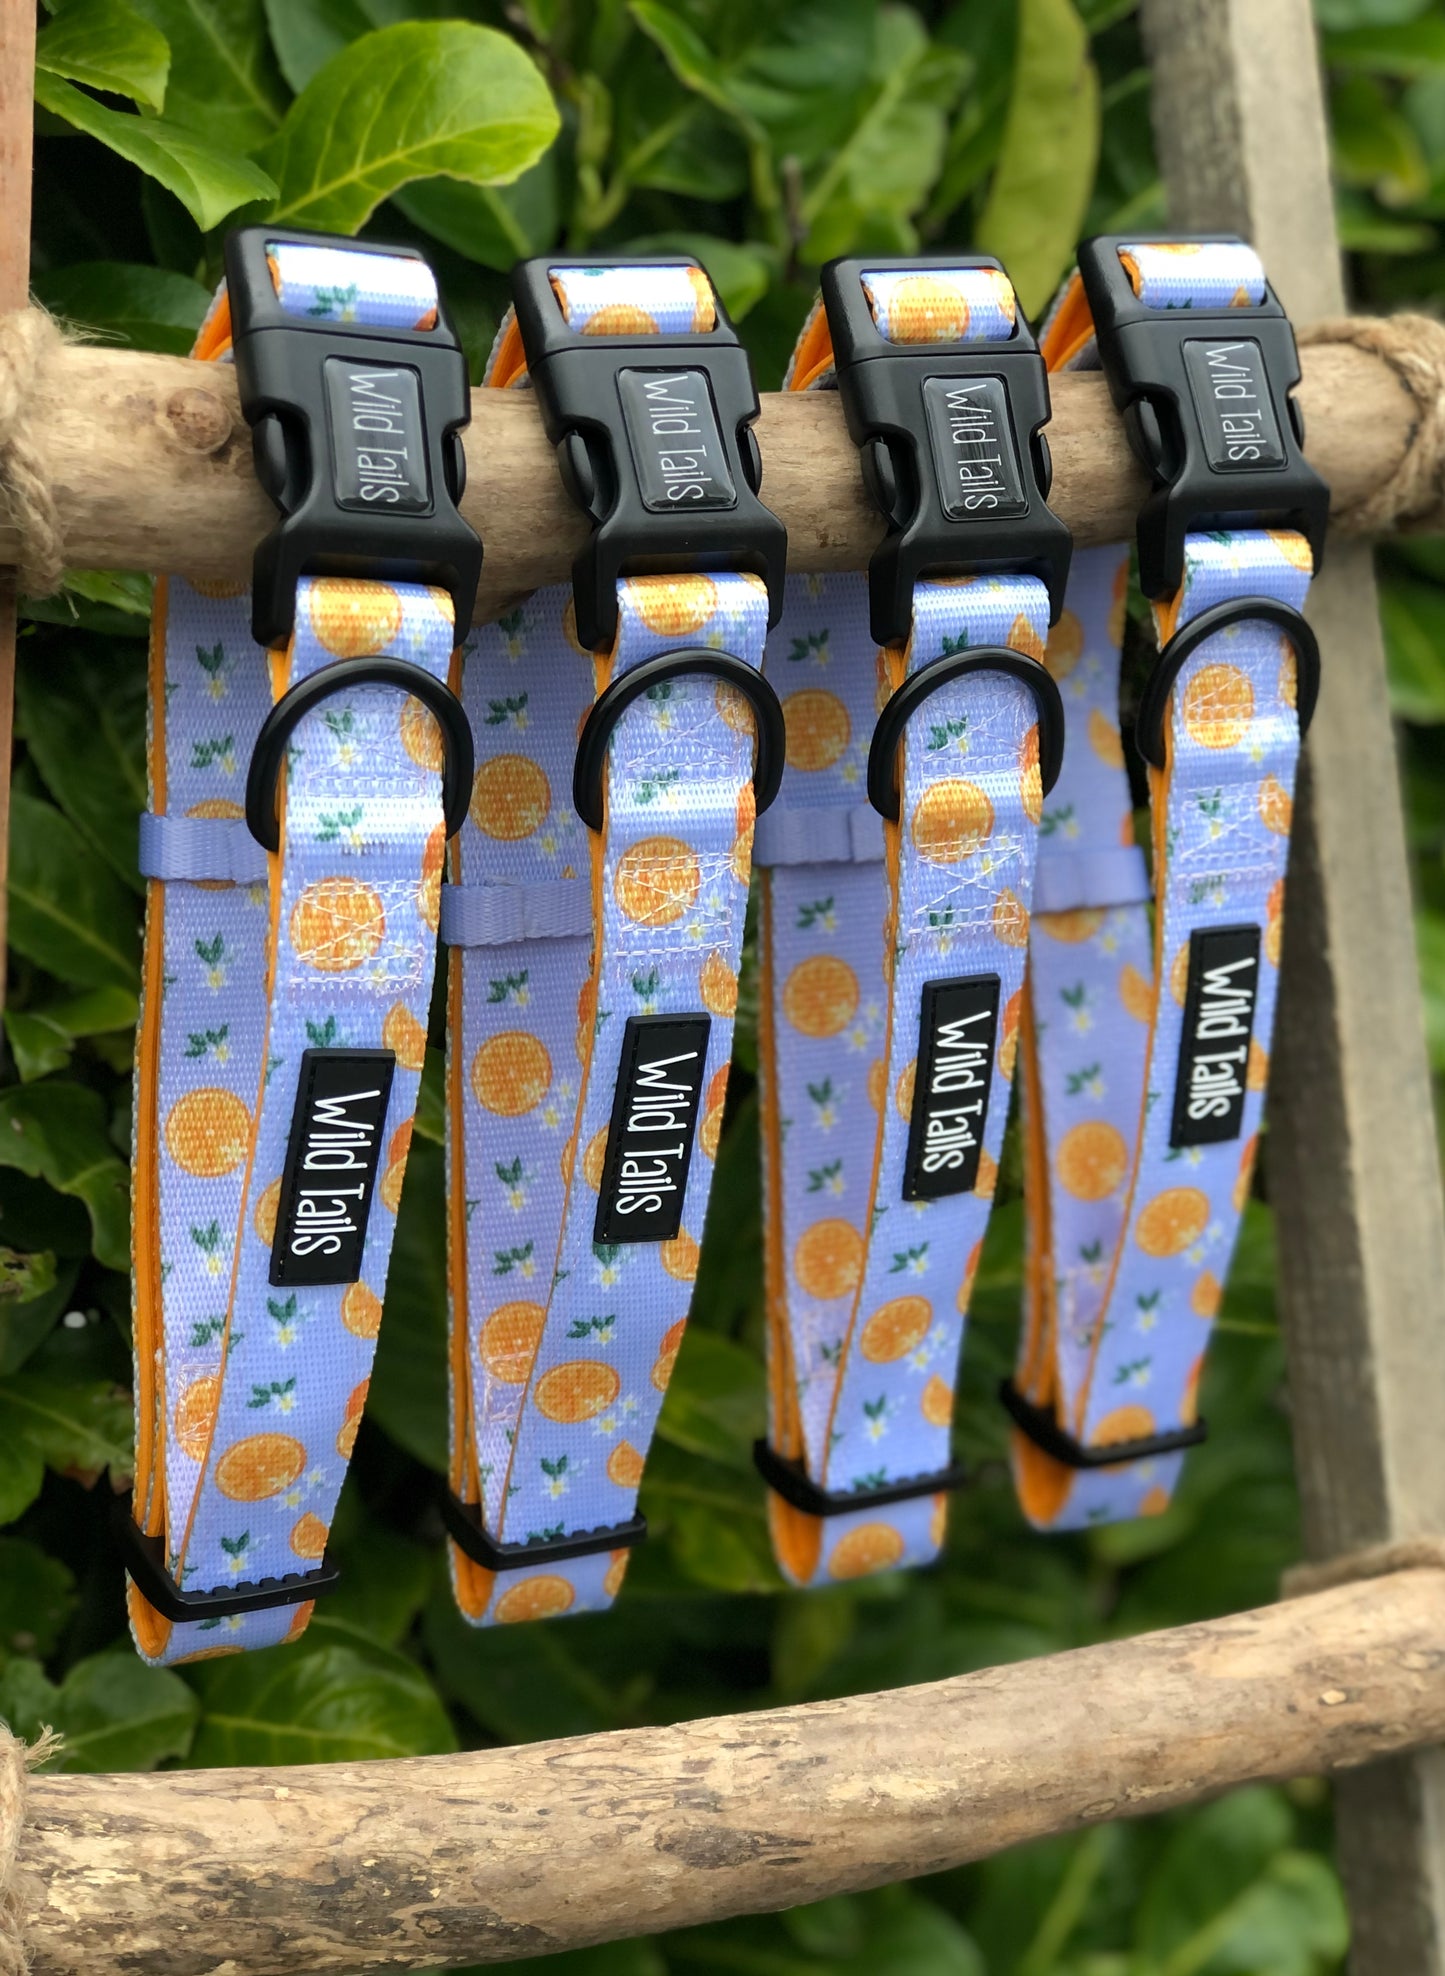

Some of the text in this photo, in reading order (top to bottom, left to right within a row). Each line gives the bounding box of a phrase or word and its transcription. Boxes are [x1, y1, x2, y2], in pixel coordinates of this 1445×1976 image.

[349, 373, 408, 504] Wild Tails
[643, 376, 712, 502] Wild Tails
[945, 385, 1005, 511] Wild Tails
[1206, 344, 1262, 462] Wild Tails
[923, 1011, 991, 1173] Wild Tails
[1188, 957, 1256, 1120] Wild Tails
[291, 1090, 380, 1256] Wild Tails
[615, 1051, 697, 1215] Wild Tails
